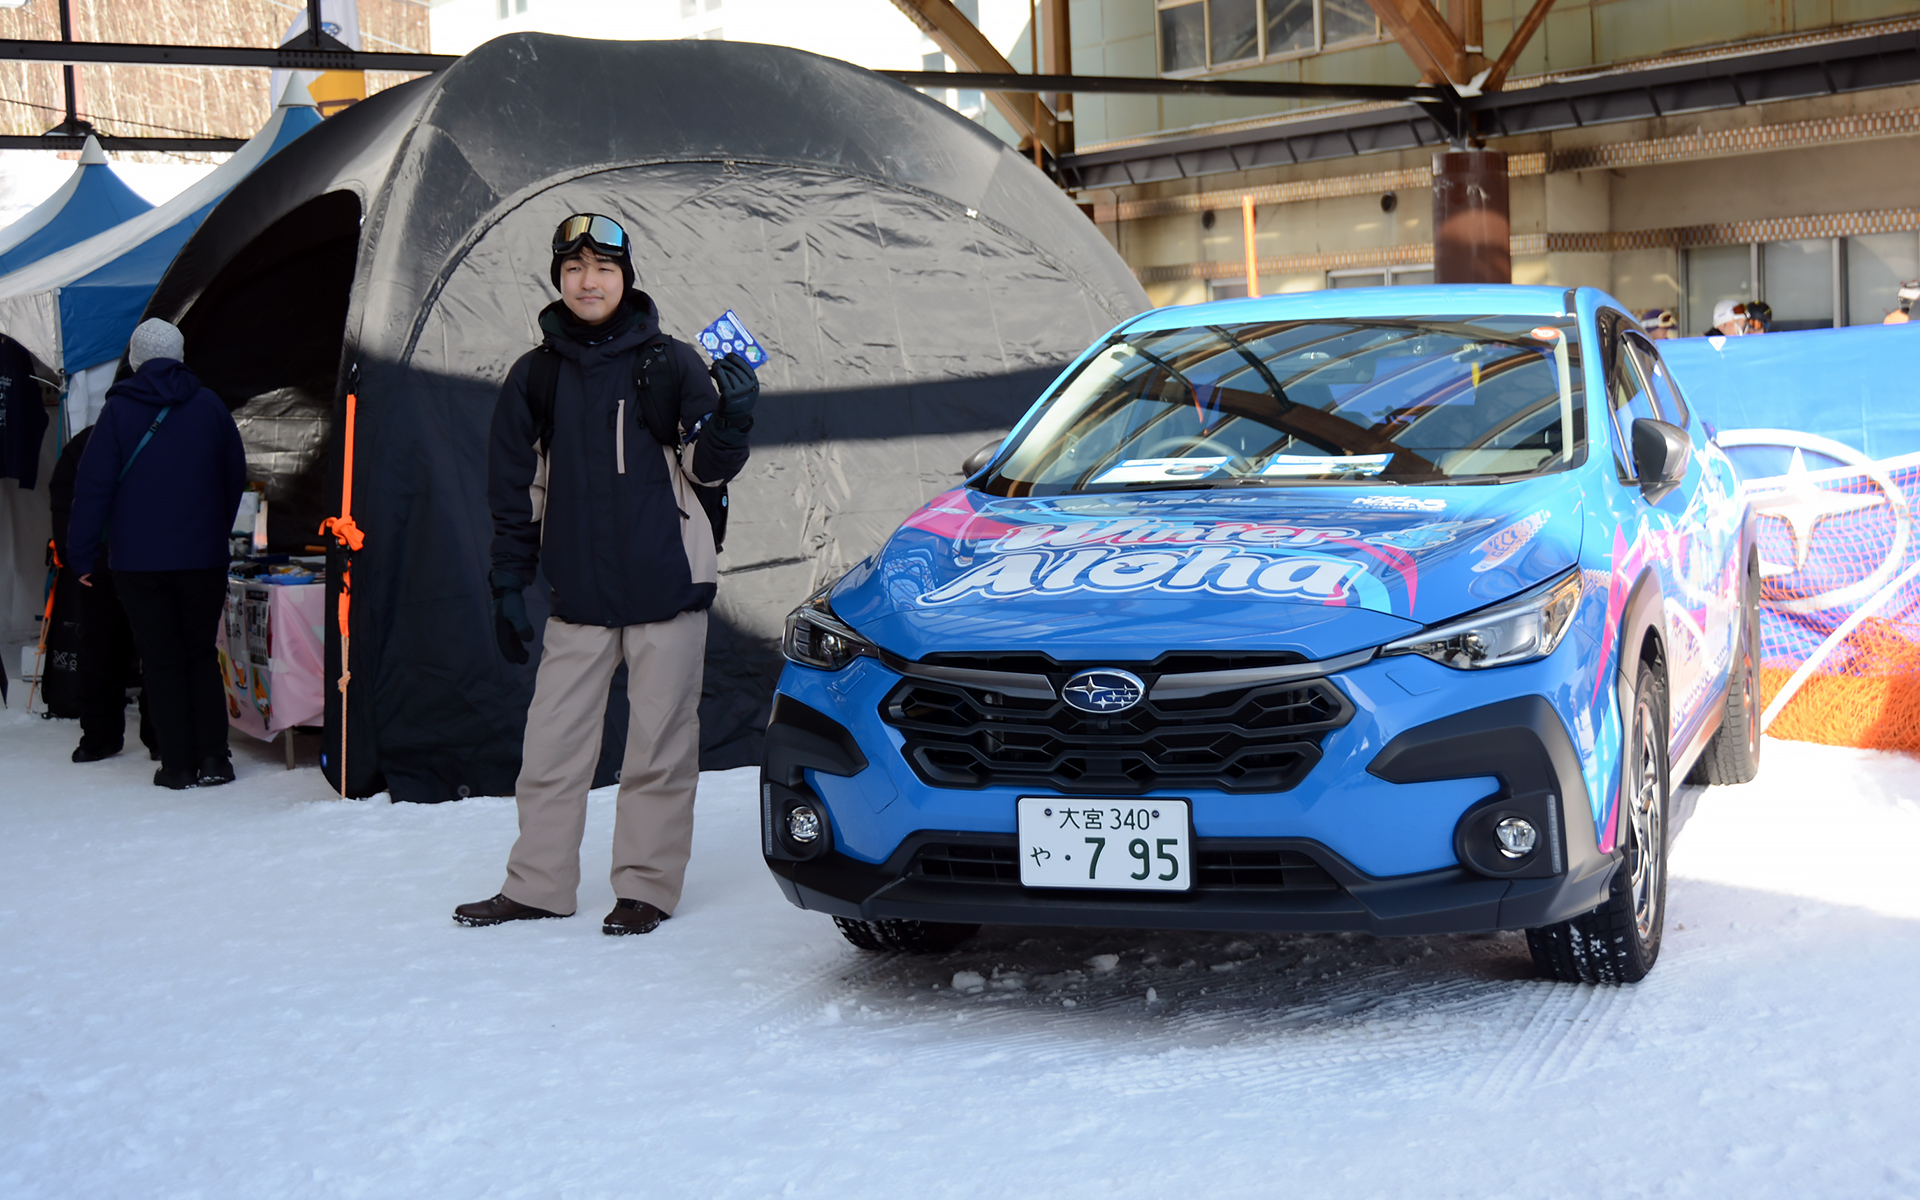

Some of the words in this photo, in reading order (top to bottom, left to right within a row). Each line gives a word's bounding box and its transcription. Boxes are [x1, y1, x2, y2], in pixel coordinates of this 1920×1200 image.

[998, 518, 1350, 551] Winter
[926, 547, 1357, 602] Aloha
[1059, 807, 1104, 829] 大宮
[1110, 808, 1150, 830] 340
[1030, 846, 1051, 867] や
